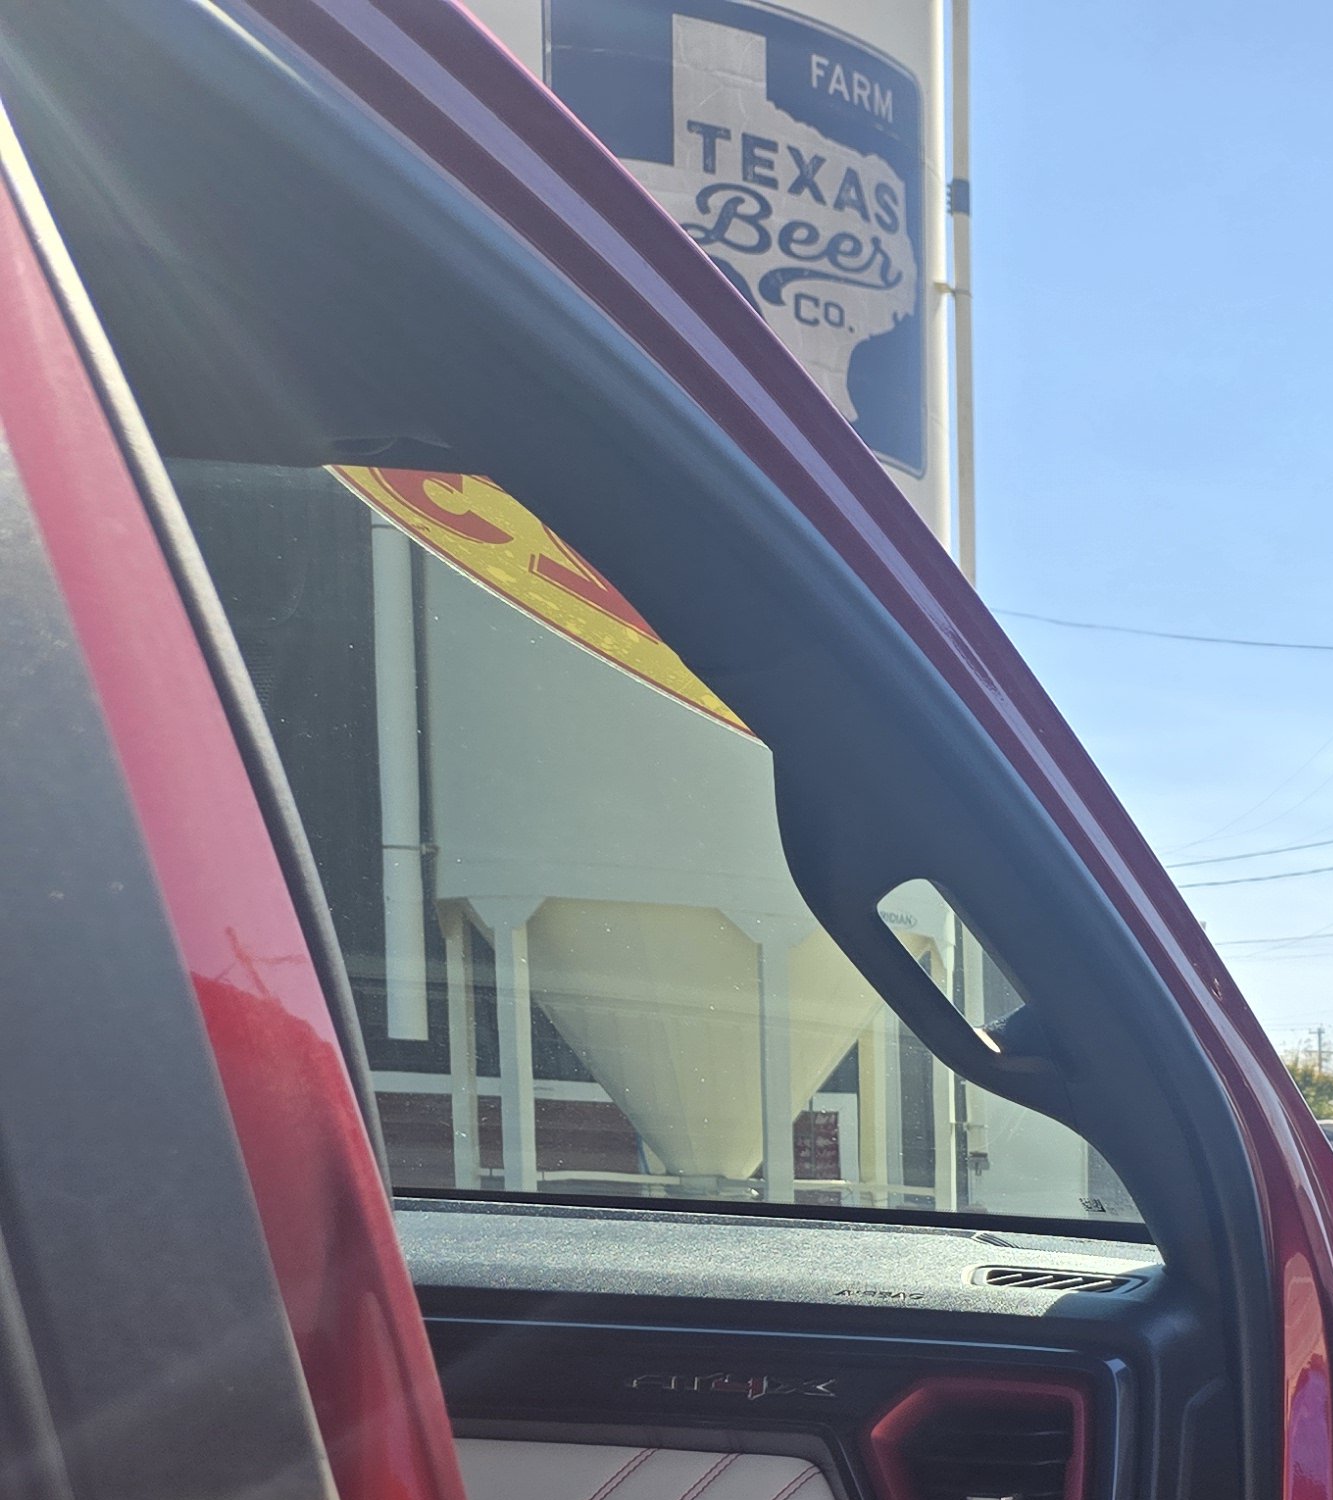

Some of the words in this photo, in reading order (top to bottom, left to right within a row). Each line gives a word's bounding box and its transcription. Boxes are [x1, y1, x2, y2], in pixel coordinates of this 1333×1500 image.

[810, 53, 893, 123] FARM
[686, 119, 900, 235] TEXAS
[682, 182, 902, 291] Beer
